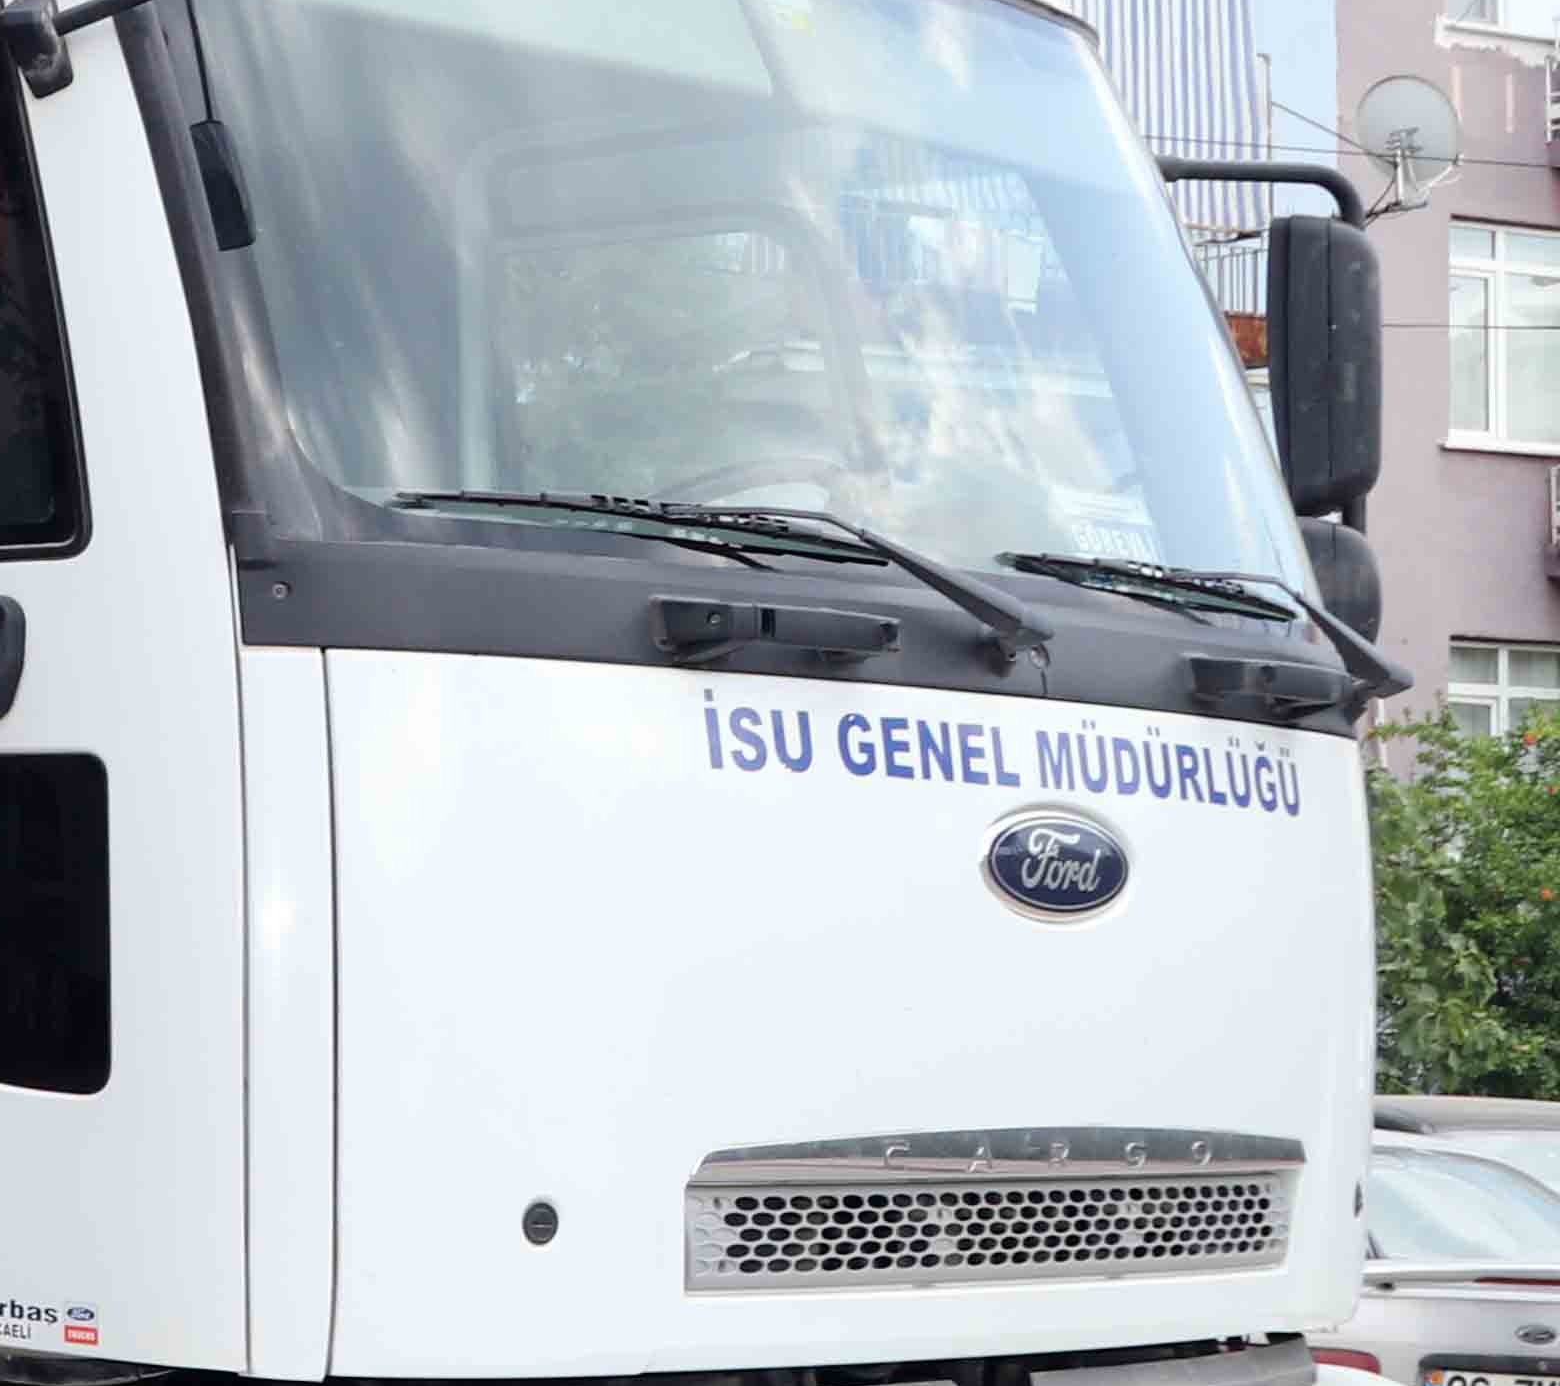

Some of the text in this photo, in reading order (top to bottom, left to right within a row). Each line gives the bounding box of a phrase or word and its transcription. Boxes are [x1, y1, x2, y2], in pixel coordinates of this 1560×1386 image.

[704, 689, 1301, 817] İSU GENEL MÜDÜRLÜĞÜ
[1021, 828, 1105, 893] Ford
[884, 1139, 1212, 1174] CARGO
